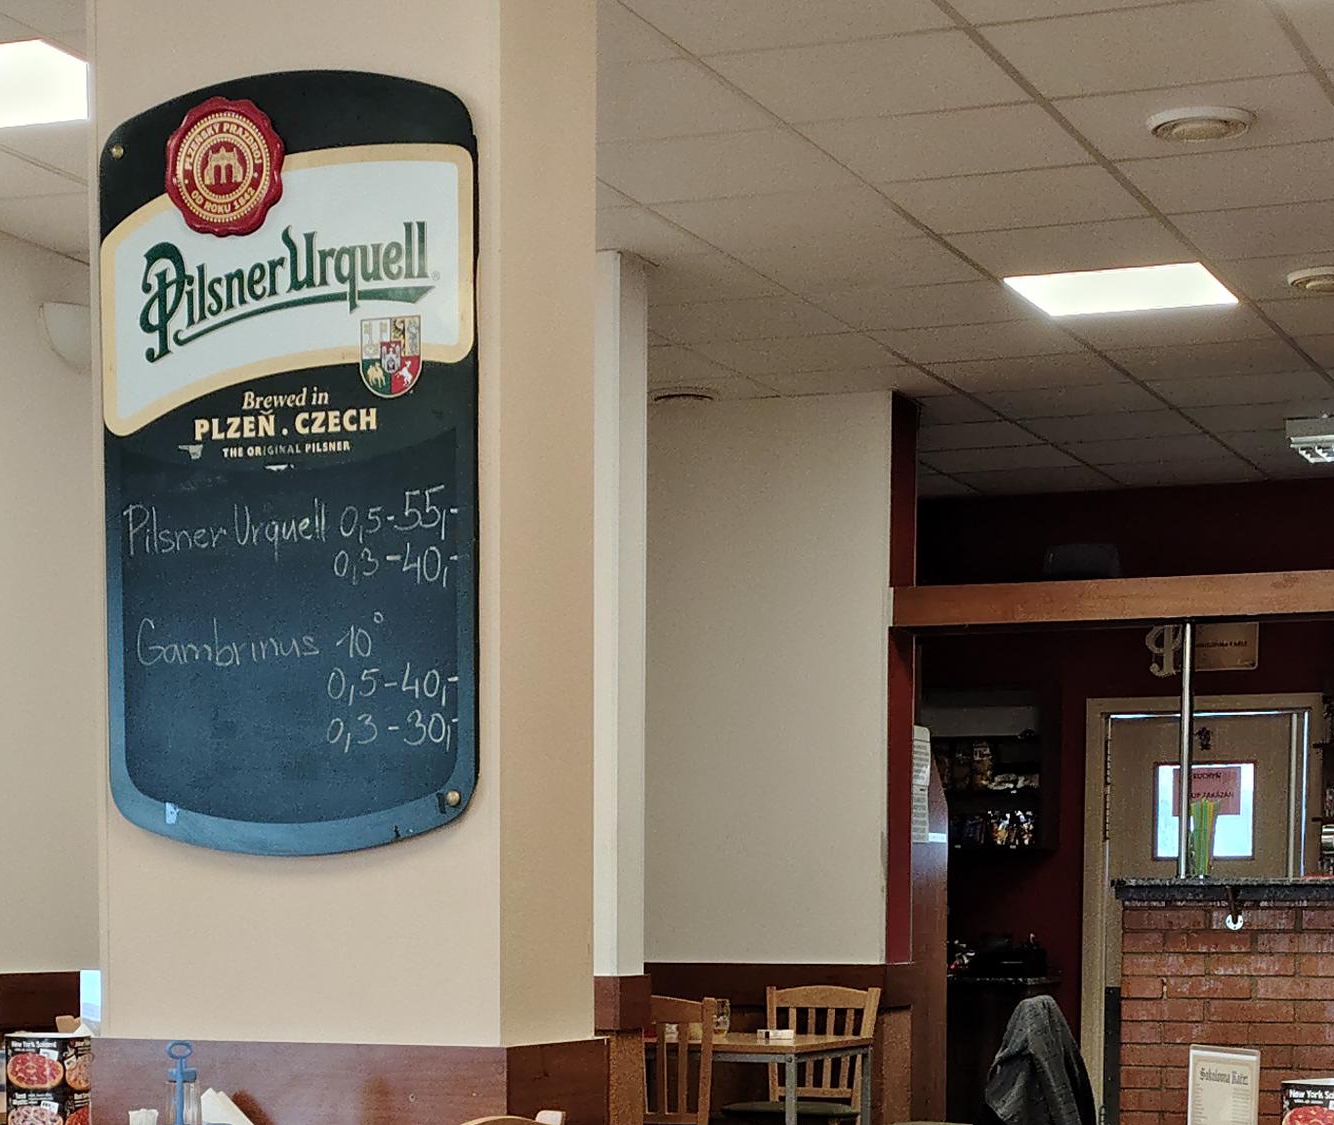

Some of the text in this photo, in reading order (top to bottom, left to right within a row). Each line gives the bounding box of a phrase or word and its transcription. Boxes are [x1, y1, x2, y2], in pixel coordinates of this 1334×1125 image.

[223, 122, 263, 164] PRAZDROJ
[204, 203, 231, 213] ROKU
[139, 221, 429, 362] Pilsner Urquell
[242, 387, 329, 410] Brewed in
[194, 408, 378, 441] PLZEŇ CZECH
[222, 446, 244, 458] THE
[304, 440, 350, 454] PILSNER
[123, 503, 227, 556] Pilsner
[233, 498, 326, 562] Urquell
[137, 617, 321, 667] Gambrinus
